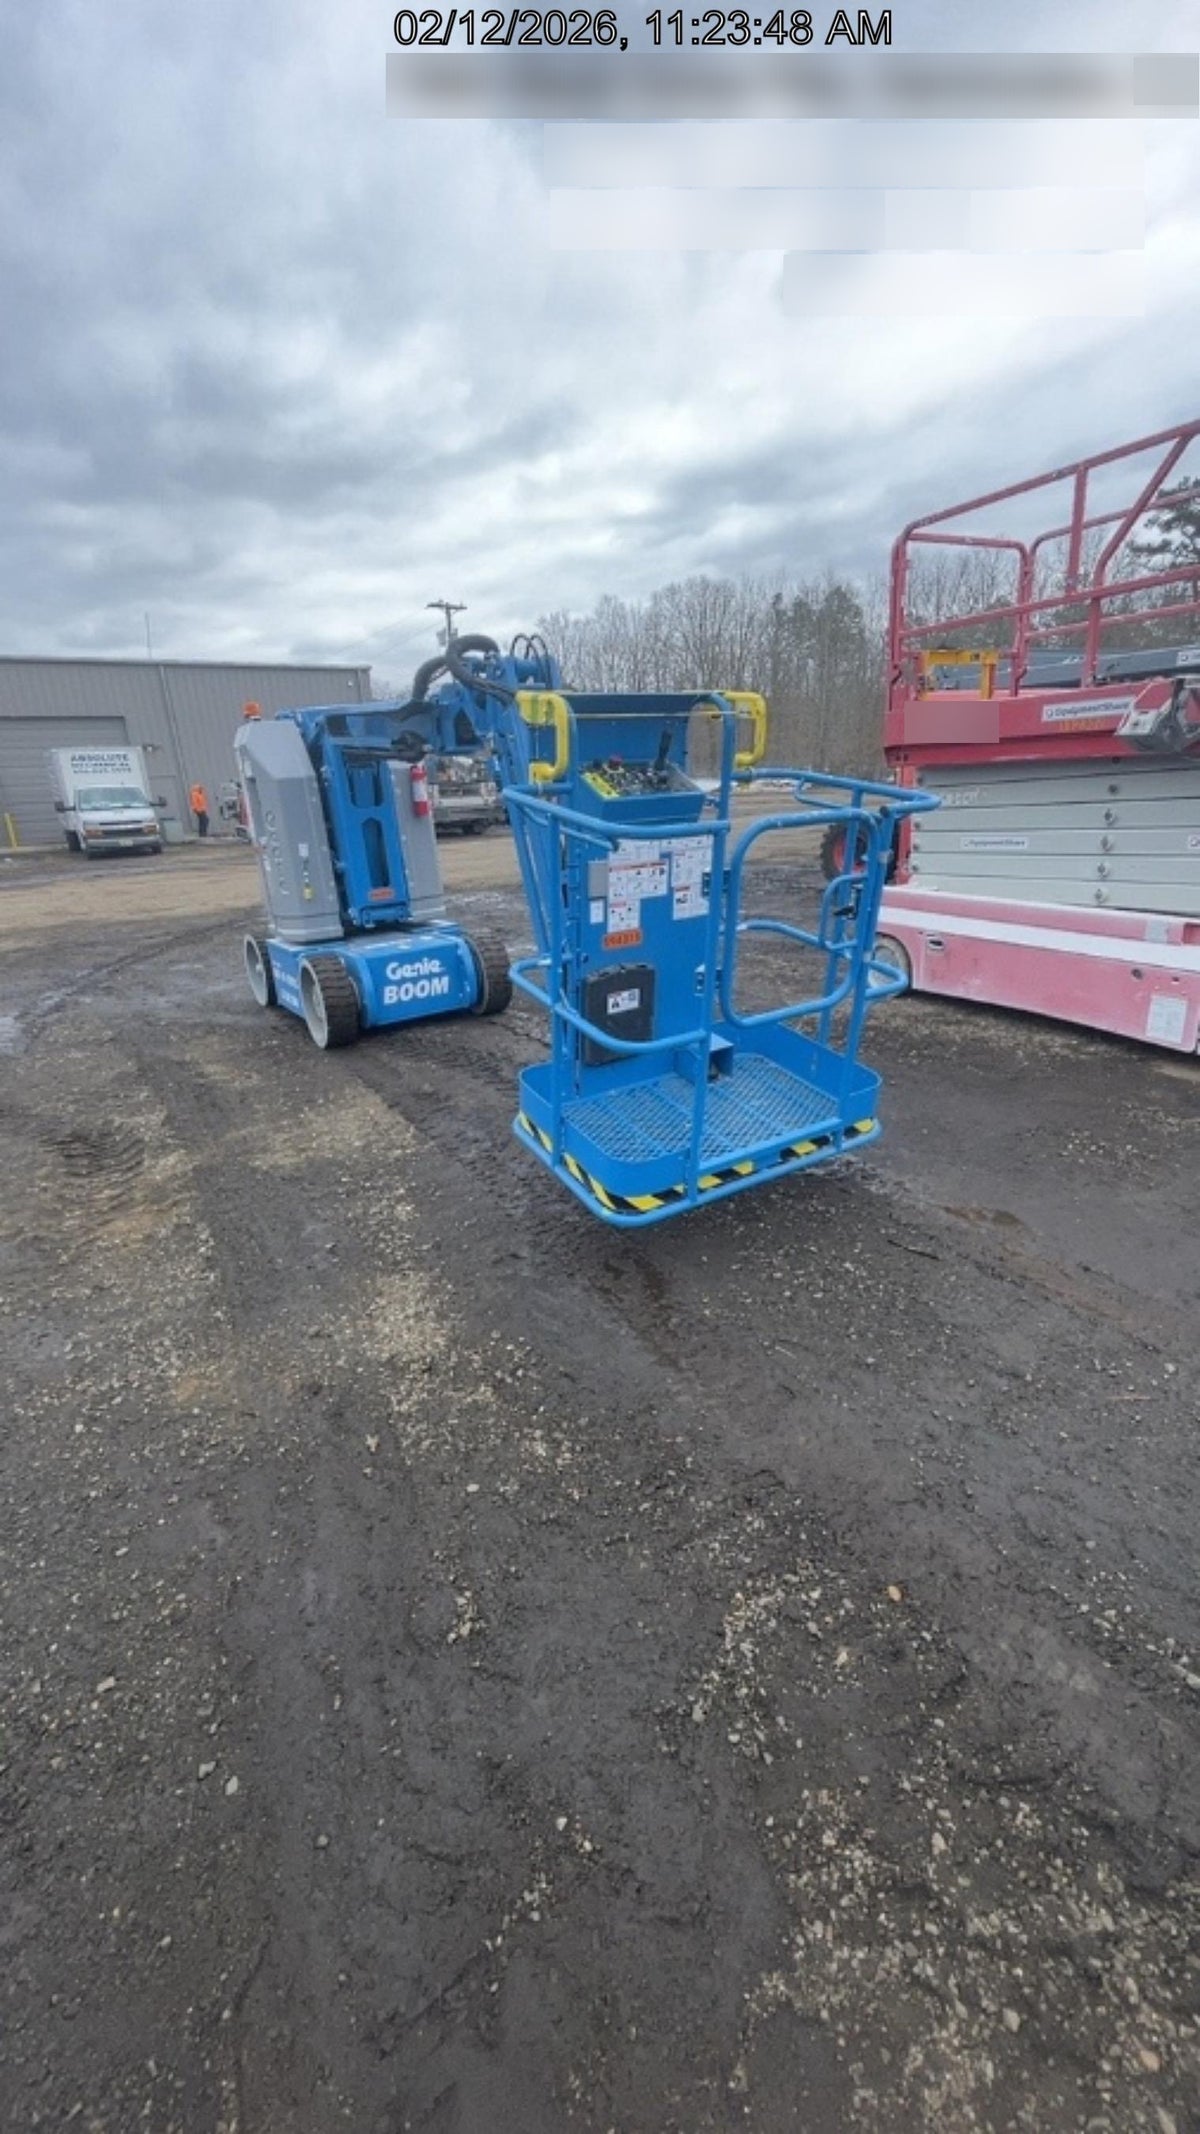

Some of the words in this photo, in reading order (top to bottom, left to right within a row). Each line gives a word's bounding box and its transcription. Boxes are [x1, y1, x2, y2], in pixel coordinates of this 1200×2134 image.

[71, 753, 129, 761] ABSOLUTE
[385, 957, 443, 980] Genie
[383, 976, 450, 1006] BOOM
